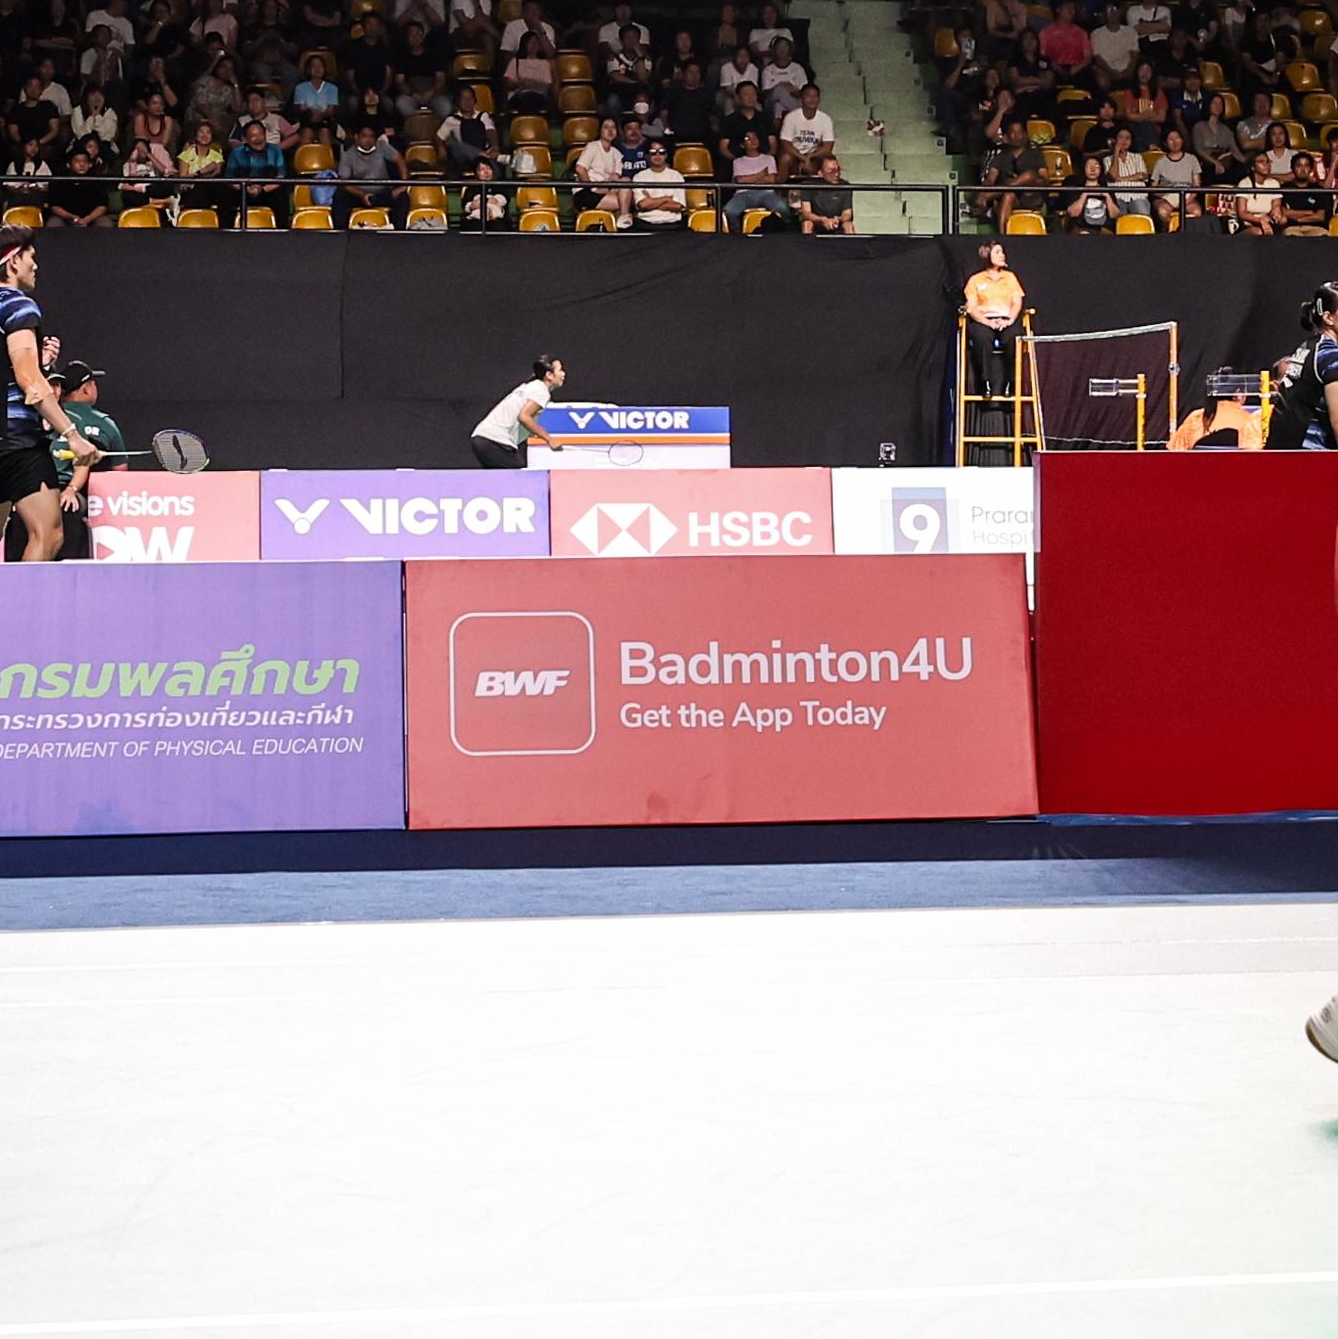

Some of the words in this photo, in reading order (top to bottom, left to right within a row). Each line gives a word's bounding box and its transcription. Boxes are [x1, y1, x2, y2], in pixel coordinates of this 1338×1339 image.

[599, 411, 689, 430] VICTOR
[107, 491, 195, 516] visions
[339, 496, 535, 534] VICTOR
[689, 511, 813, 547] HSBC
[618, 637, 973, 686] Badminton4U
[474, 669, 571, 697] BWF
[619, 702, 672, 728] Get
[678, 702, 724, 727] the
[731, 702, 792, 733] App
[799, 700, 887, 731] Today
[122, 741, 150, 758] OF
[154, 739, 247, 756] PHYSICAL
[251, 737, 364, 755] EDUCATION
